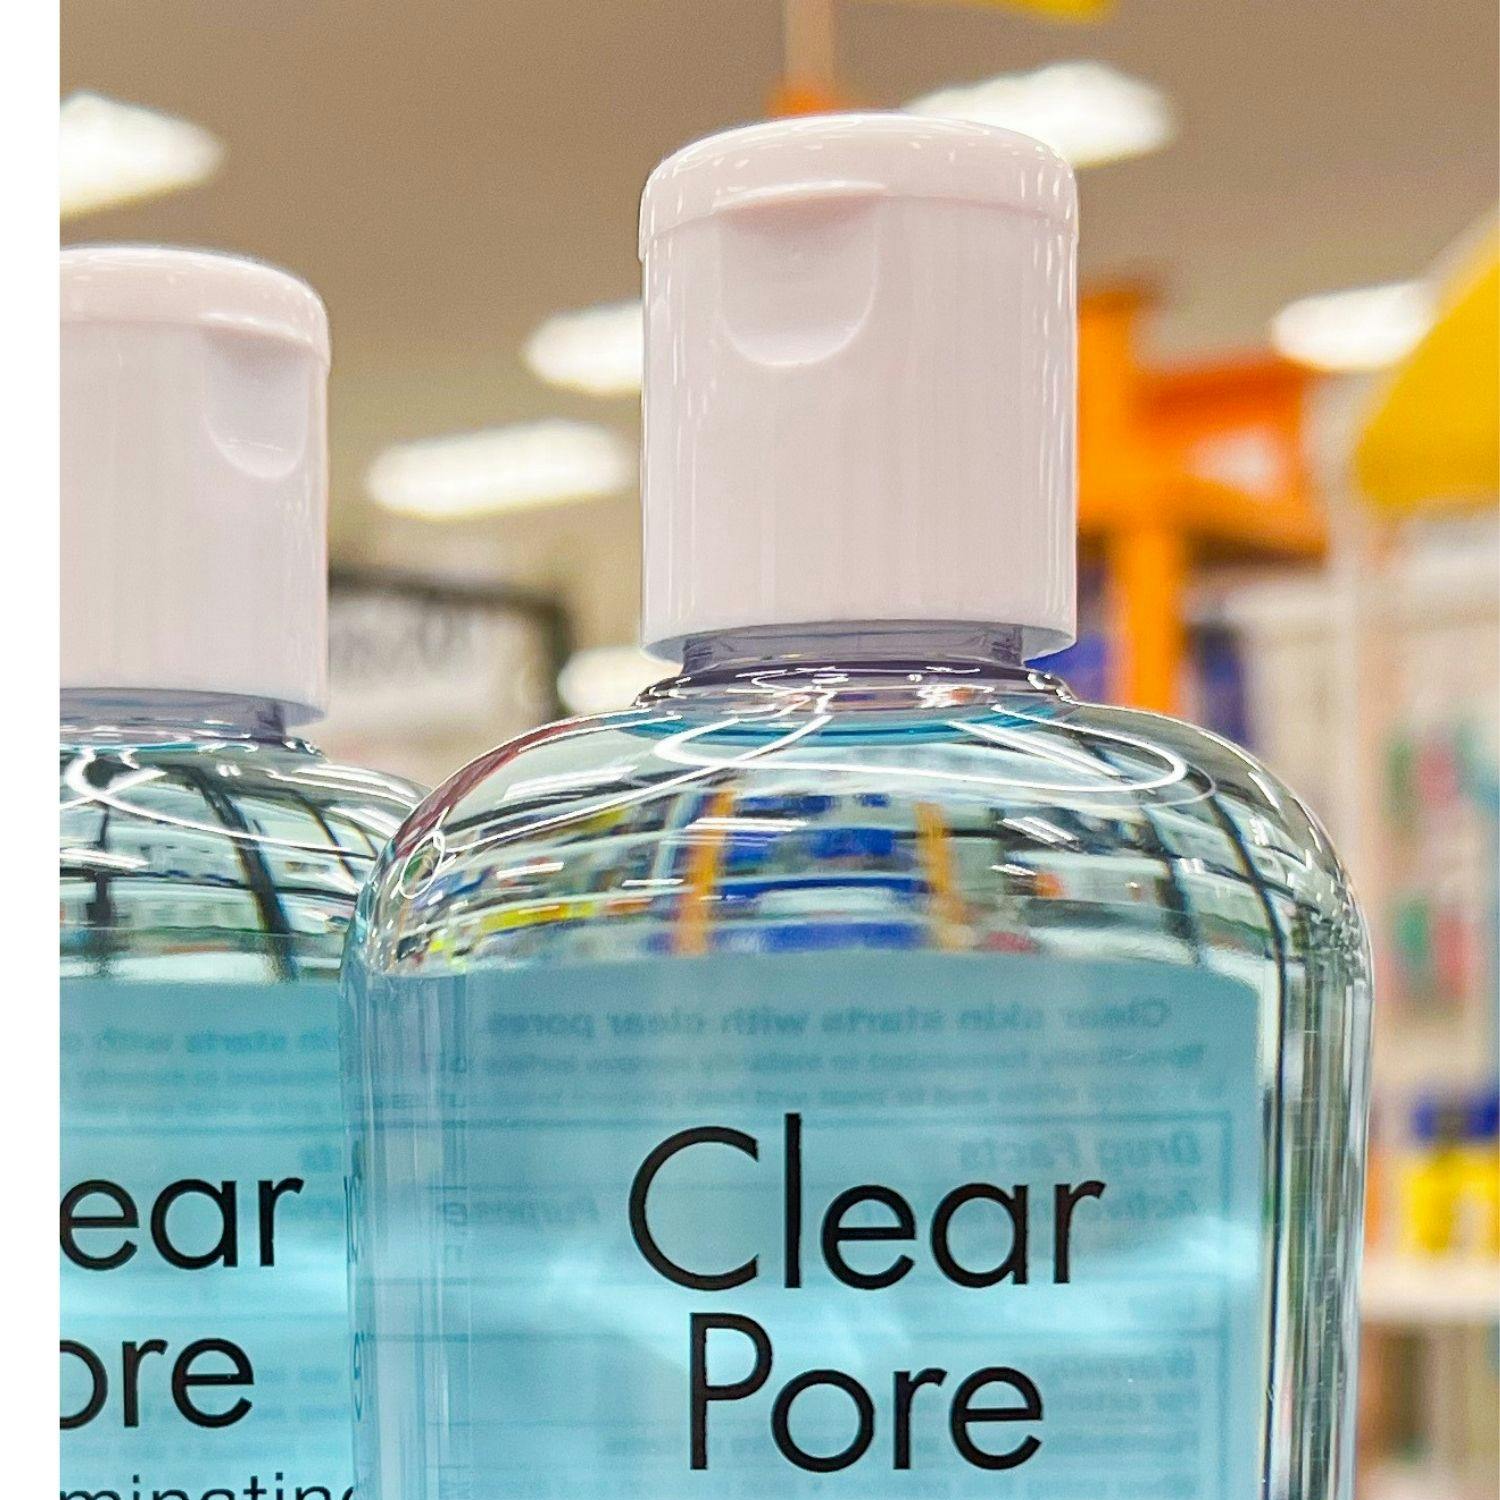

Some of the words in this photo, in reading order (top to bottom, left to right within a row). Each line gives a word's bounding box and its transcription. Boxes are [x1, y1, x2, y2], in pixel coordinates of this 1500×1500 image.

[60, 1177, 304, 1270] ear
[629, 1113, 1105, 1291] Clear
[689, 1312, 1043, 1473] Pore
